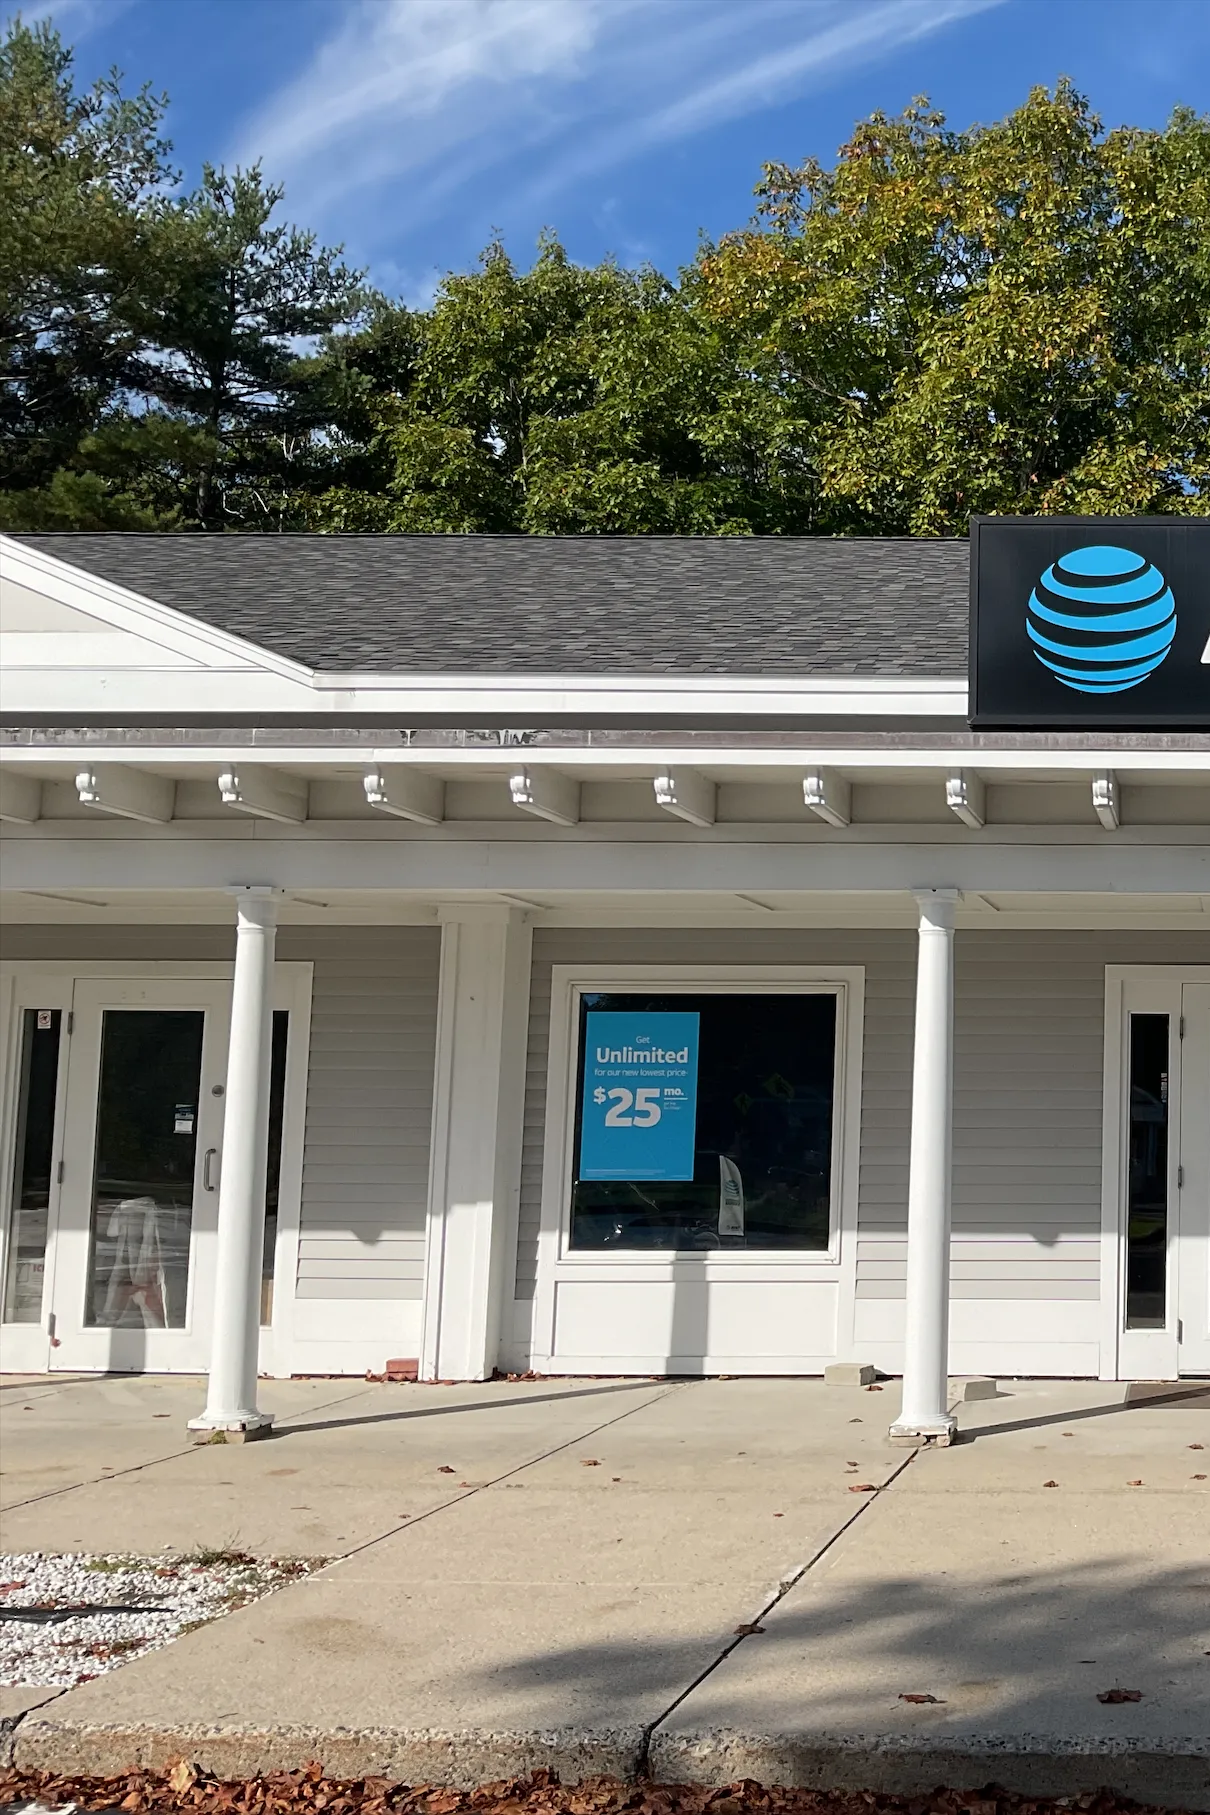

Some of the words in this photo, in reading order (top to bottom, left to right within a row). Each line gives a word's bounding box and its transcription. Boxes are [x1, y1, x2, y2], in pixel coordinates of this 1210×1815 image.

[635, 1036, 650, 1044] Get
[596, 1047, 689, 1064] Unlimited
[594, 1068, 605, 1076] for
[640, 1068, 665, 1076] lowest
[593, 1086, 661, 1128] $25
[663, 1088, 684, 1096] mo.
